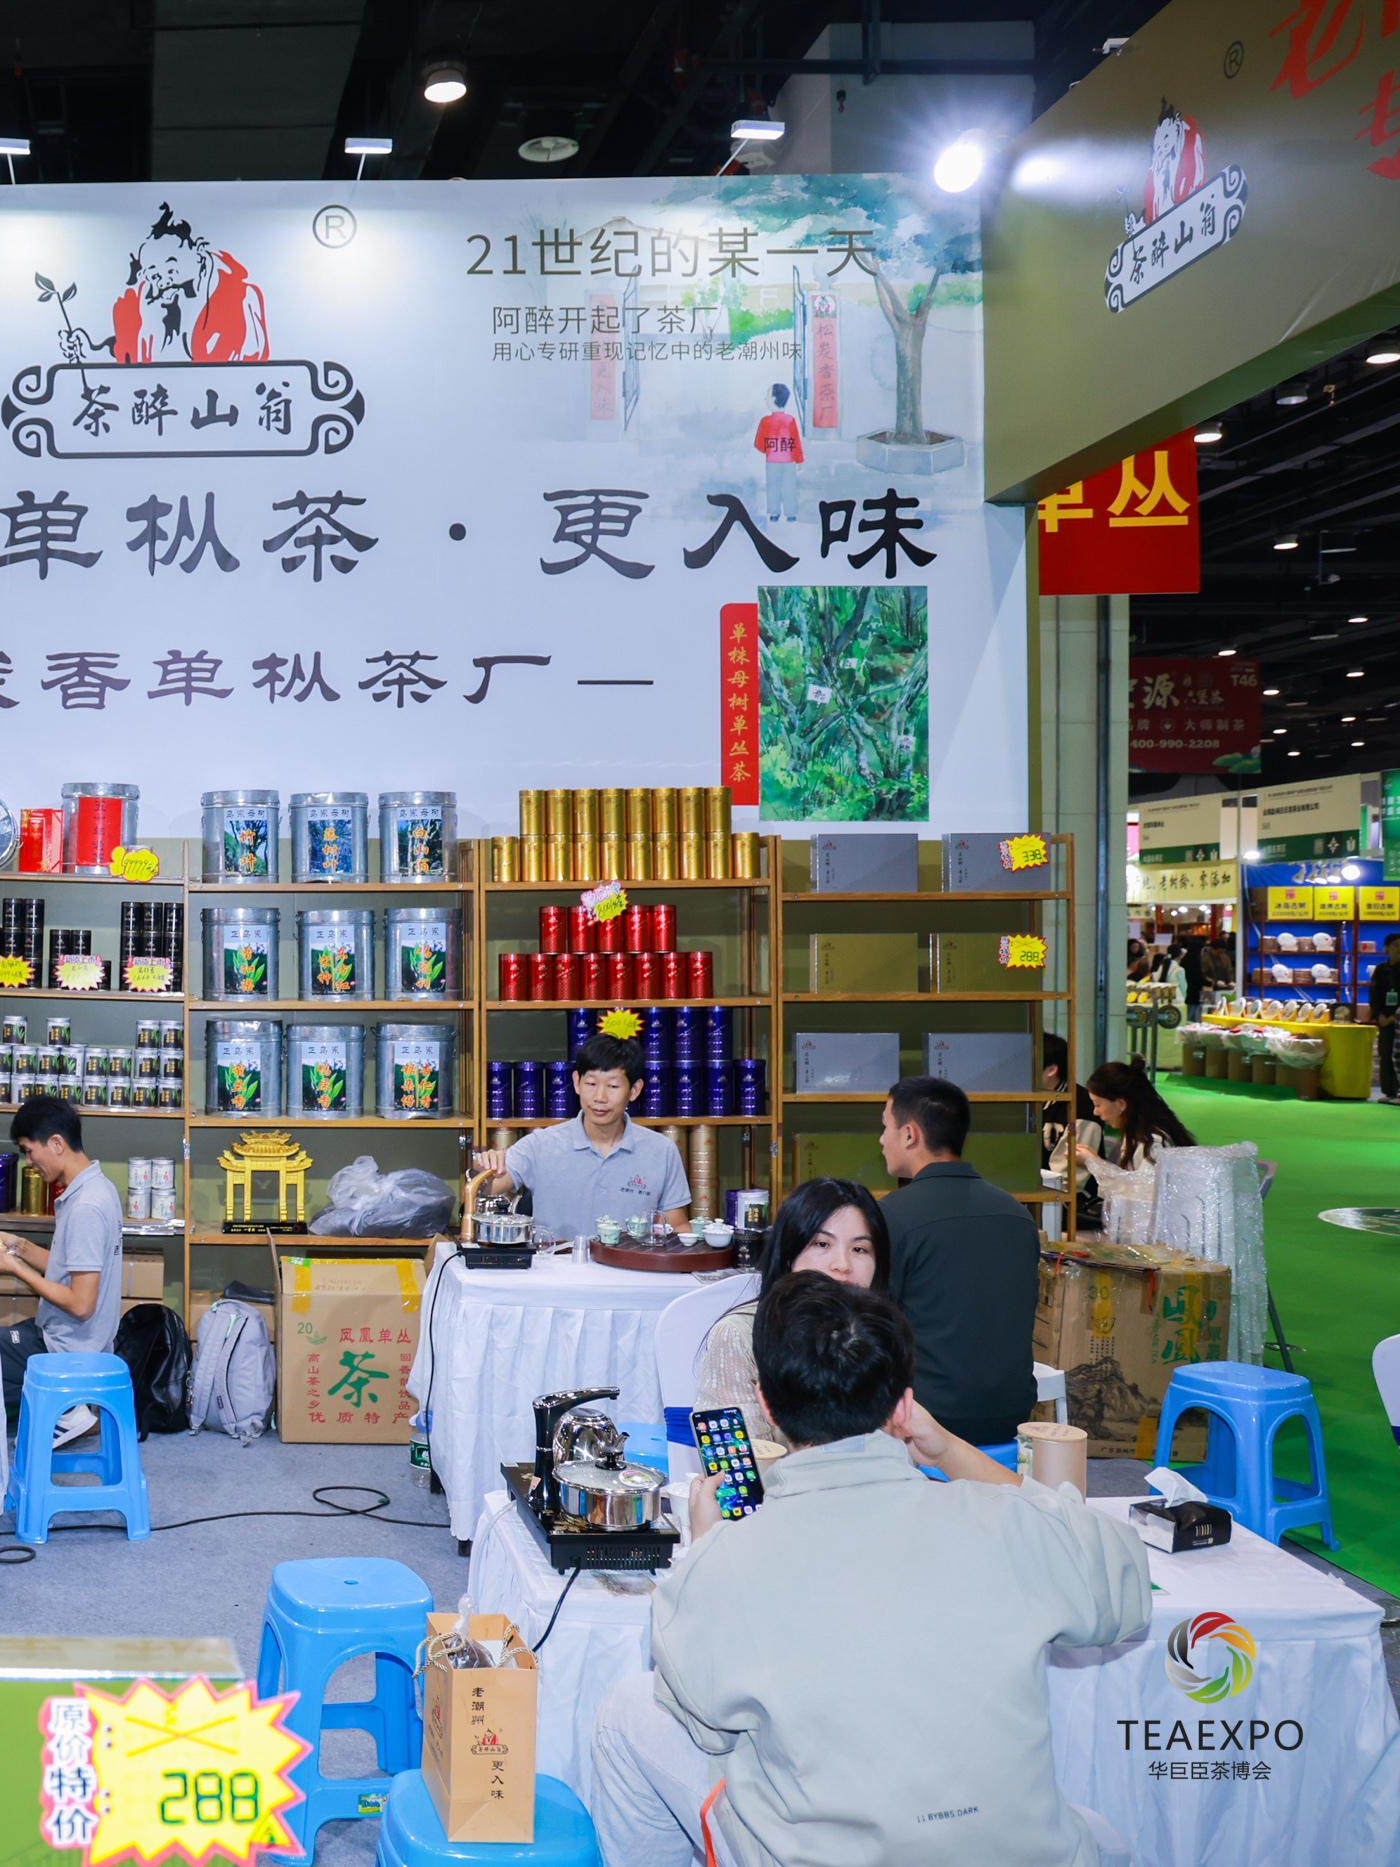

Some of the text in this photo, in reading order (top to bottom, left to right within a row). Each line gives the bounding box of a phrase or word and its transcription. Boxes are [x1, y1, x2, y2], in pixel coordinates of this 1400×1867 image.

[466, 227, 878, 278] 21世纪的某一天
[1130, 194, 1216, 285] 茶醉山翁
[492, 306, 719, 336] 阿醉开起了茶厂
[492, 340, 803, 362] 用心专研重现记忆中的老潮州味
[72, 381, 293, 437] 茶醉山翁
[764, 437, 797, 453] 阿醉
[1230, 674, 1257, 687] T46
[727, 621, 751, 783] 单株母树单丛茶
[239, 828, 256, 873] 竹叶
[1023, 849, 1043, 862] 338
[1020, 951, 1040, 963] 288
[297, 1322, 313, 1335] 20
[339, 1328, 412, 1344] 凤凰单丛
[307, 1353, 321, 1409] 高山茶之乡
[328, 1351, 389, 1407] 茶
[309, 1411, 410, 1424] 优质特产
[471, 1687, 485, 1726] 老潮州
[491, 1760, 505, 1800] 更入味
[160, 1772, 259, 1823] 288
[957, 1805, 980, 1818] DARK
